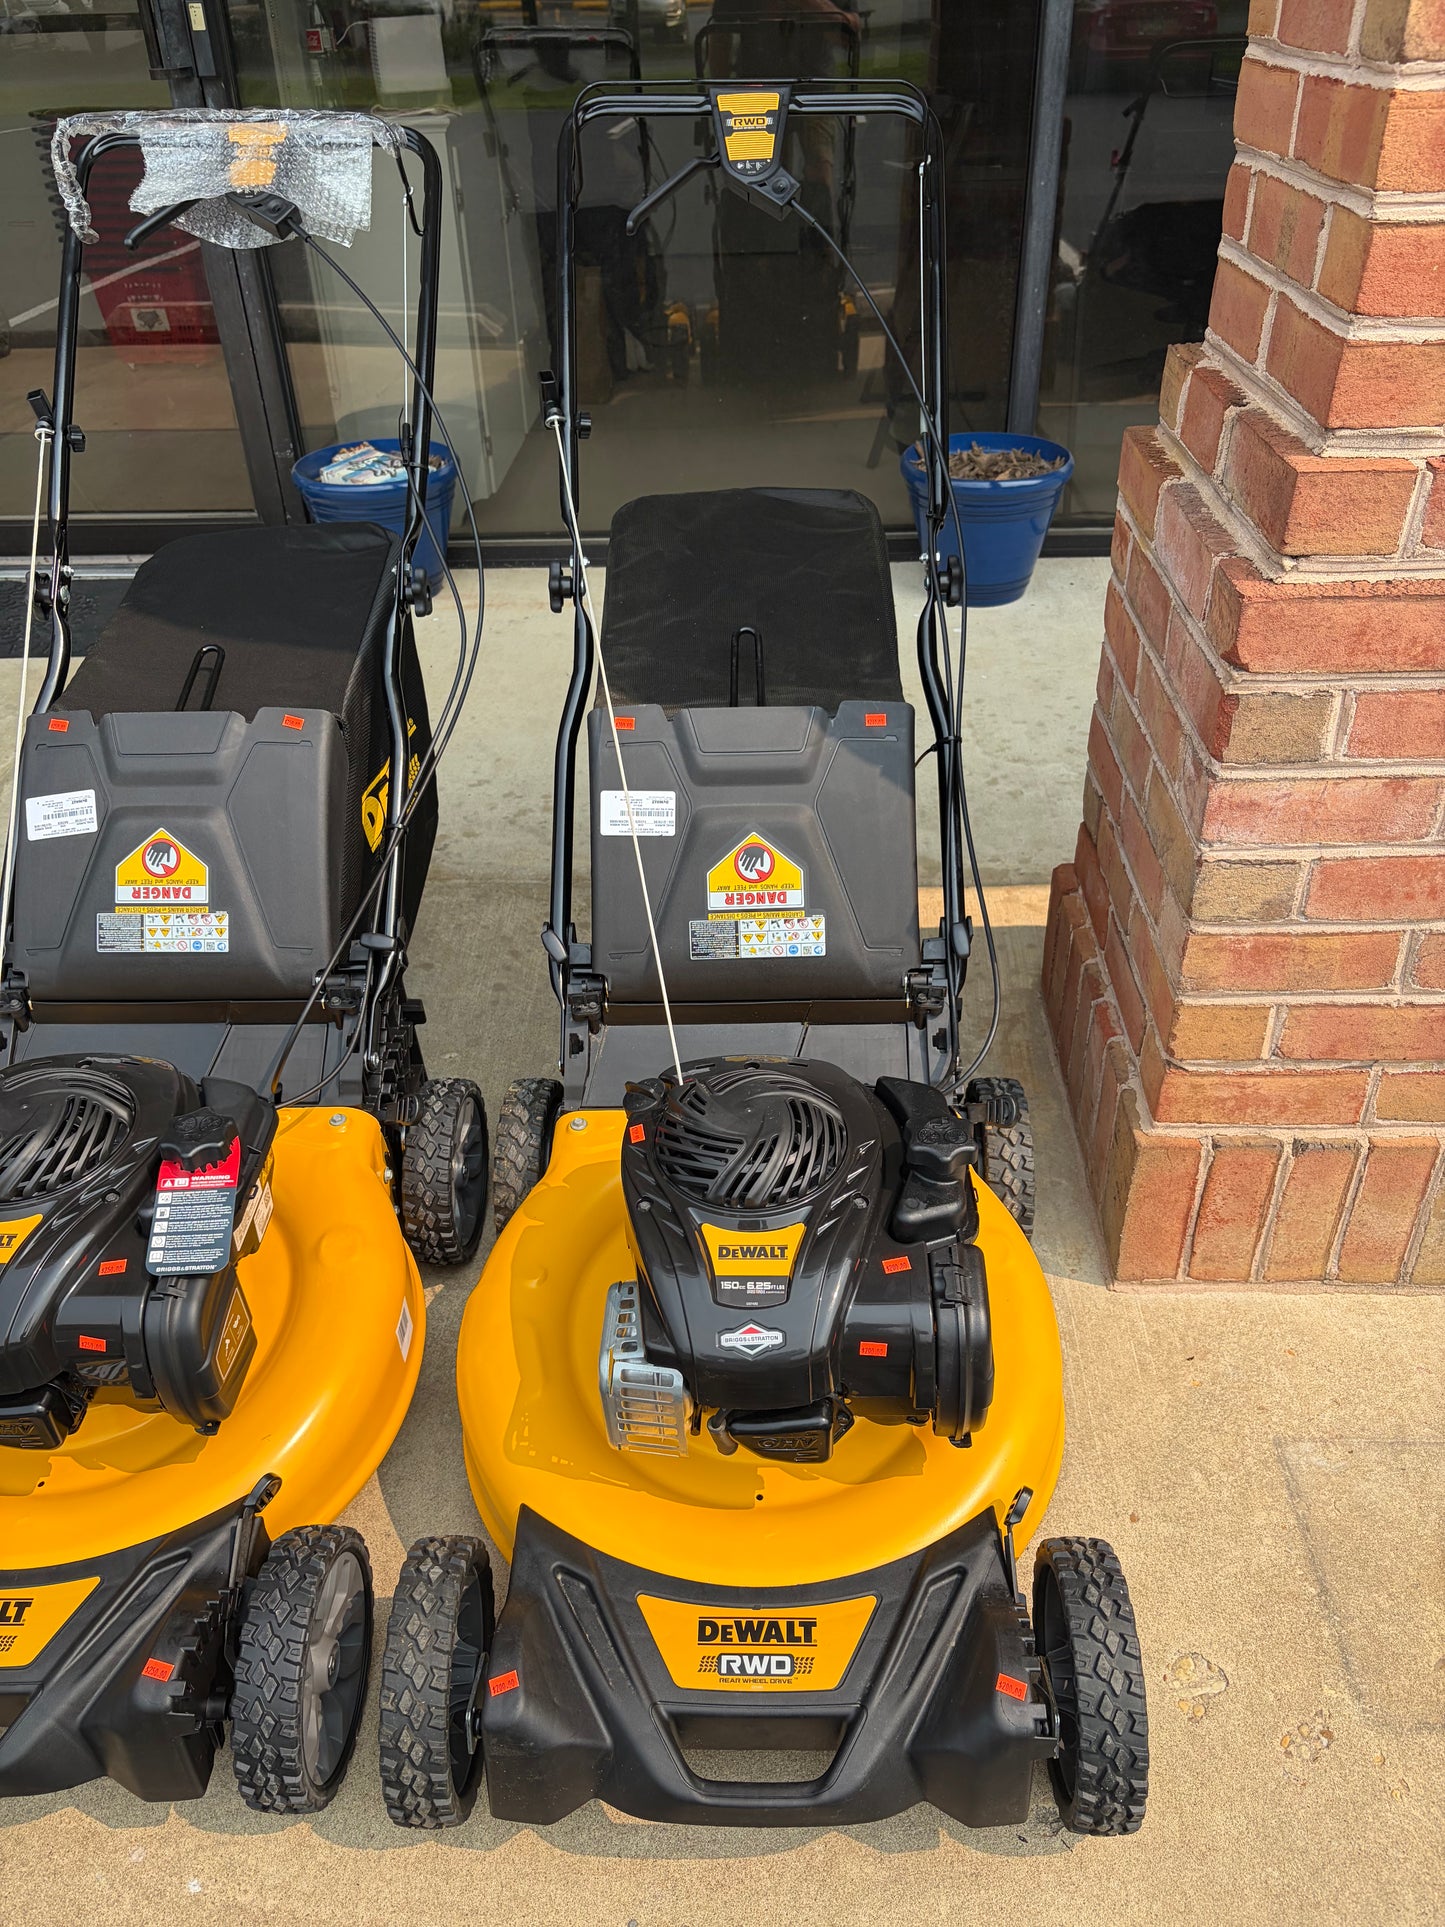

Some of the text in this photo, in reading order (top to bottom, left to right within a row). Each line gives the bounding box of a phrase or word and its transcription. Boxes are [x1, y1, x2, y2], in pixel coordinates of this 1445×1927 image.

[733, 117, 766, 127] RWD
[131, 886, 192, 899] DANGER
[724, 890, 787, 906] DANGER
[718, 1246, 788, 1258] DeWALT
[697, 1619, 818, 1643] DeWALT
[145, 1665, 168, 1679] $250.00
[720, 1655, 791, 1675] RWD
[492, 1678, 516, 1694] $200.00
[998, 1680, 1023, 1697] $200.00
